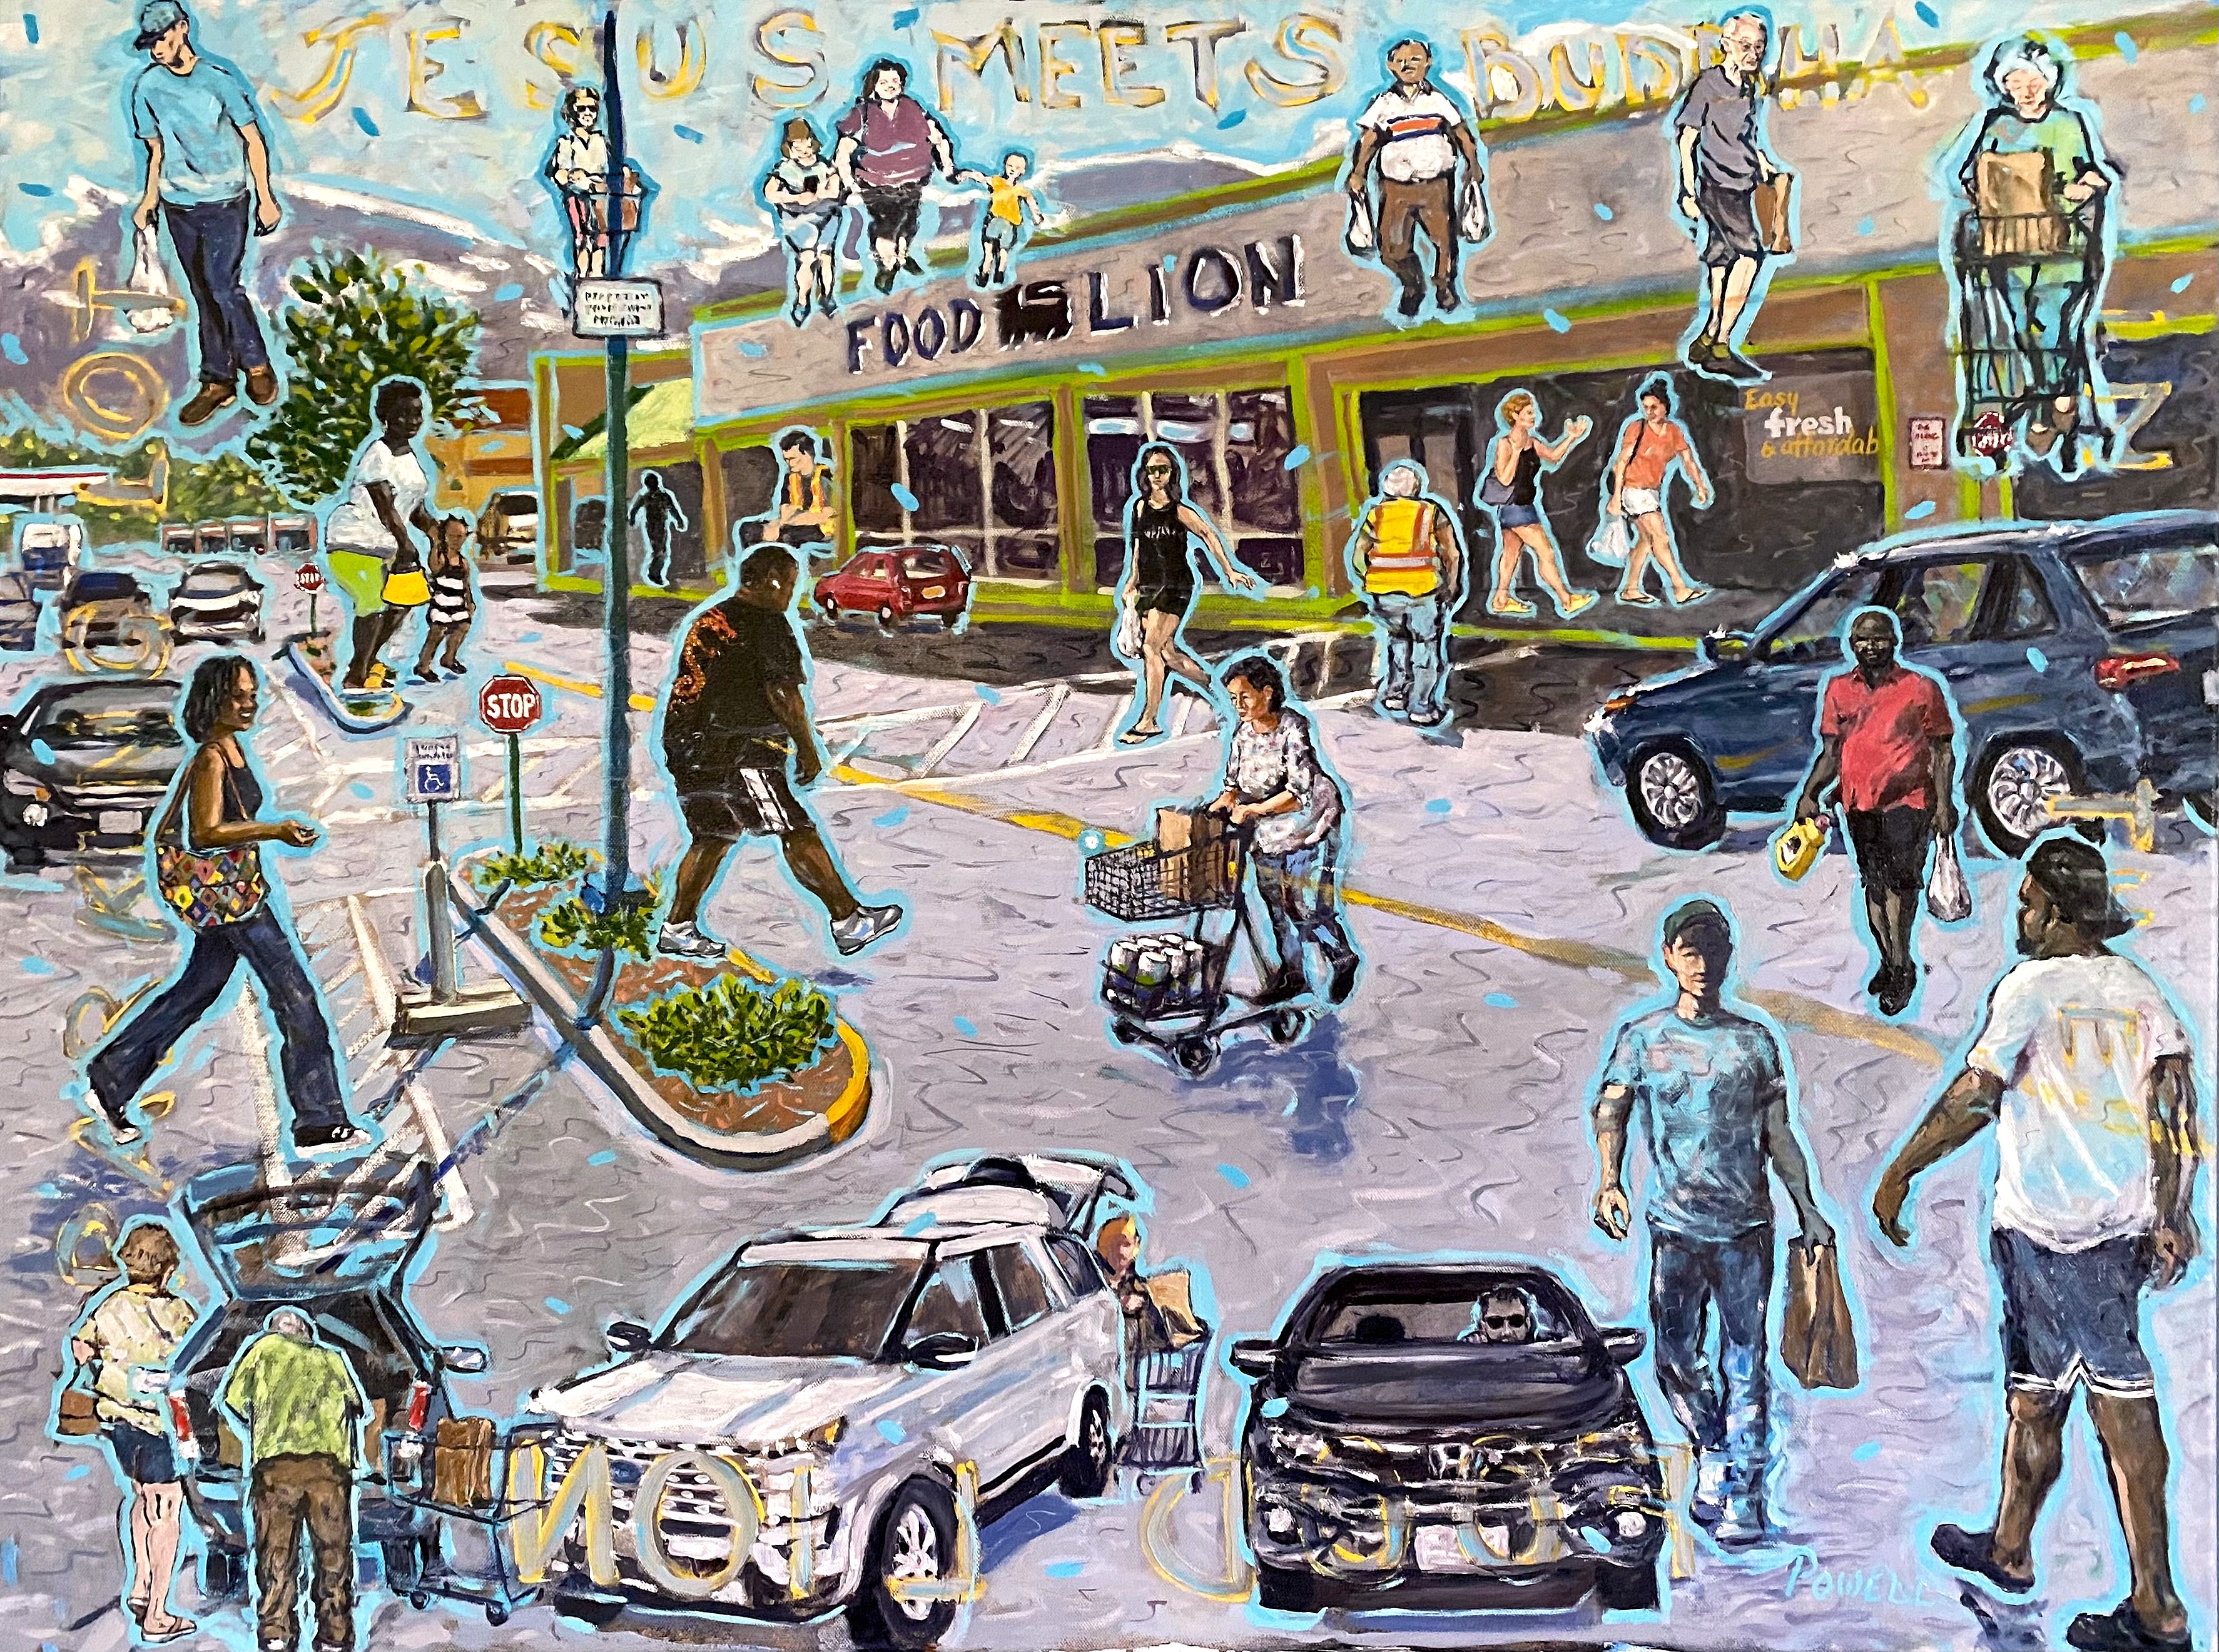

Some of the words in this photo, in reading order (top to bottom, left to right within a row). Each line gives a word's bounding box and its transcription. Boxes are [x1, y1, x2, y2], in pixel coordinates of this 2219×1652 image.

[268, 8, 830, 123] JESUS
[930, 14, 1347, 113] MEETS
[846, 296, 983, 375] FOOD
[1089, 233, 1306, 336] LION
[63, 255, 188, 517] LOT
[1744, 388, 1799, 417] Easy
[1764, 406, 1853, 438] fresh
[487, 692, 536, 719] STOP
